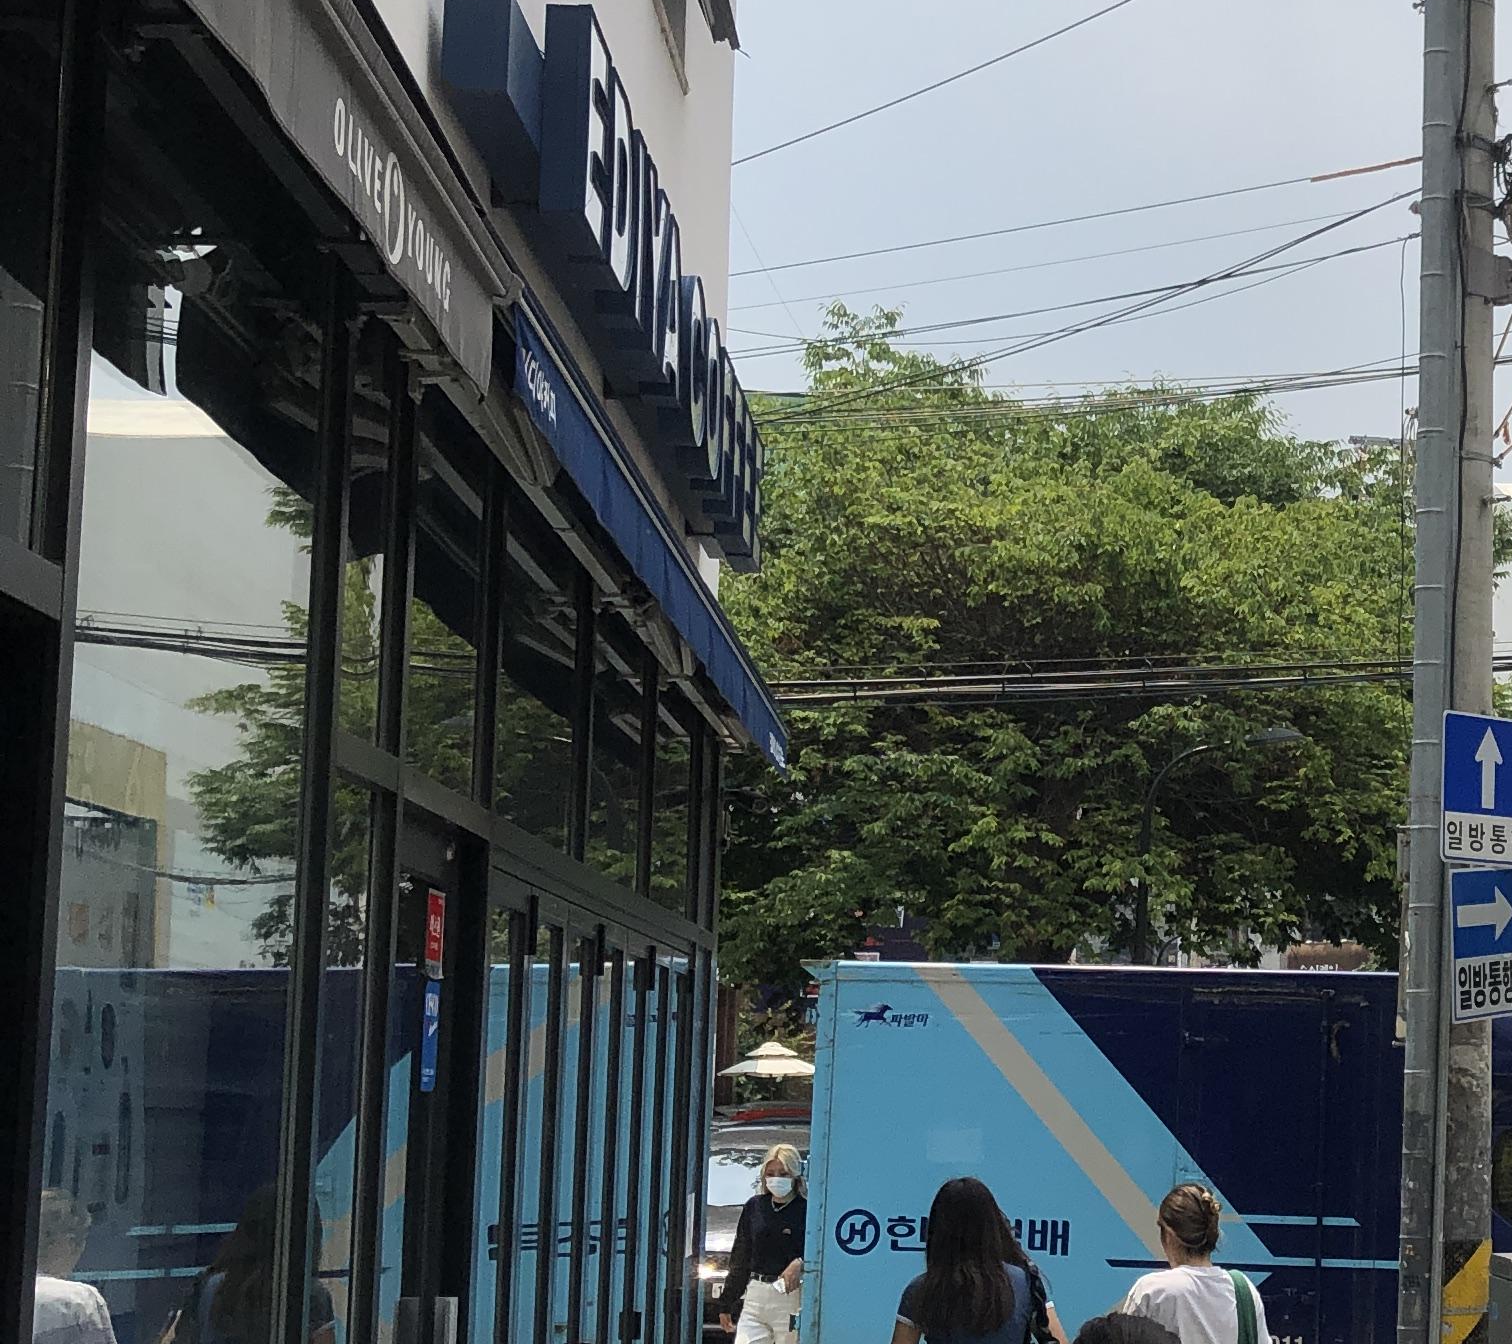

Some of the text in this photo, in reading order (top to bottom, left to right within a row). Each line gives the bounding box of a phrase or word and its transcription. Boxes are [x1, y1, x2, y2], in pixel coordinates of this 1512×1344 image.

[333, 97, 382, 214] OLIVE
[407, 203, 451, 313] YOUNG
[583, 2, 681, 402] EDIYA
[886, 1216, 1070, 1257] 한배
